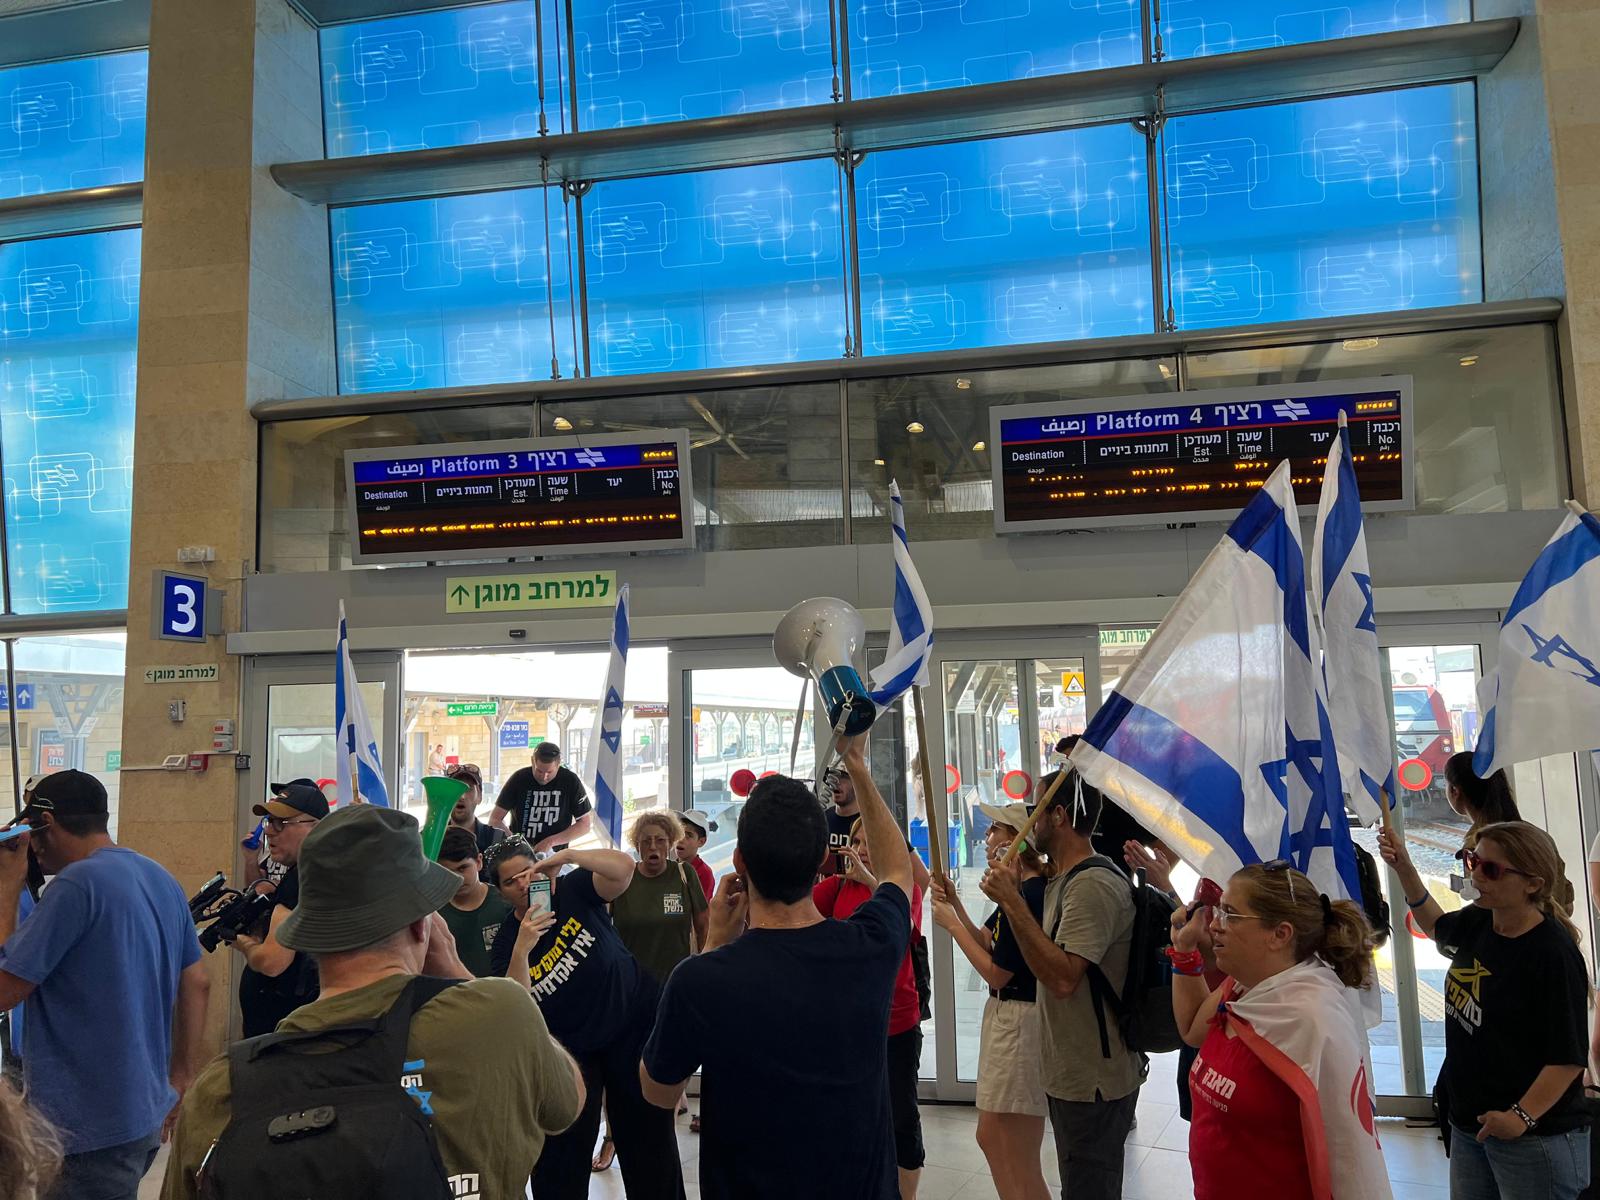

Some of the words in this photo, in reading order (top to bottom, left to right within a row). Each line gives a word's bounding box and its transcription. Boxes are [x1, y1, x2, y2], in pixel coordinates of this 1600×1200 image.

[1041, 418, 1086, 434] رصيف
[1096, 411, 1180, 430] Platform
[1189, 407, 1203, 424] 4
[1215, 403, 1262, 426] רציף
[1373, 421, 1401, 433] רכבת
[1183, 433, 1222, 447] מעודכן
[1236, 431, 1262, 442] שעה
[1310, 431, 1329, 442] יעד
[1378, 434, 1396, 444] No.
[1099, 445, 1131, 456] ביניים
[1134, 442, 1169, 454] תחנות
[1194, 447, 1212, 456] Est.
[1238, 443, 1262, 453] Time
[1012, 449, 1065, 461] Destination
[387, 461, 424, 476] رصيف
[431, 456, 500, 473] Platform
[507, 454, 518, 469] 3
[528, 451, 567, 471] רציף
[656, 469, 679, 479] רכבת
[504, 477, 536, 490] מעודכן
[547, 475, 569, 486] שעה
[606, 477, 623, 487] יעד
[661, 480, 675, 489] No.
[364, 489, 408, 500] Destination
[436, 487, 463, 497] ביניים
[464, 484, 493, 496] תחנות
[513, 489, 529, 498] Est.
[548, 486, 569, 496] Time
[528, 574, 609, 600] למרחב
[475, 582, 521, 608] מוגן
[171, 584, 197, 633] 3
[1101, 631, 1118, 643] מוג
[154, 669, 175, 682] מוגן
[178, 666, 216, 679] למרחב
[532, 790, 561, 806] דמו
[529, 806, 560, 826] קרט
[526, 822, 543, 838] יה
[560, 917, 582, 937] בלי
[571, 928, 596, 958] אין
[529, 936, 567, 980] דמוקרטי
